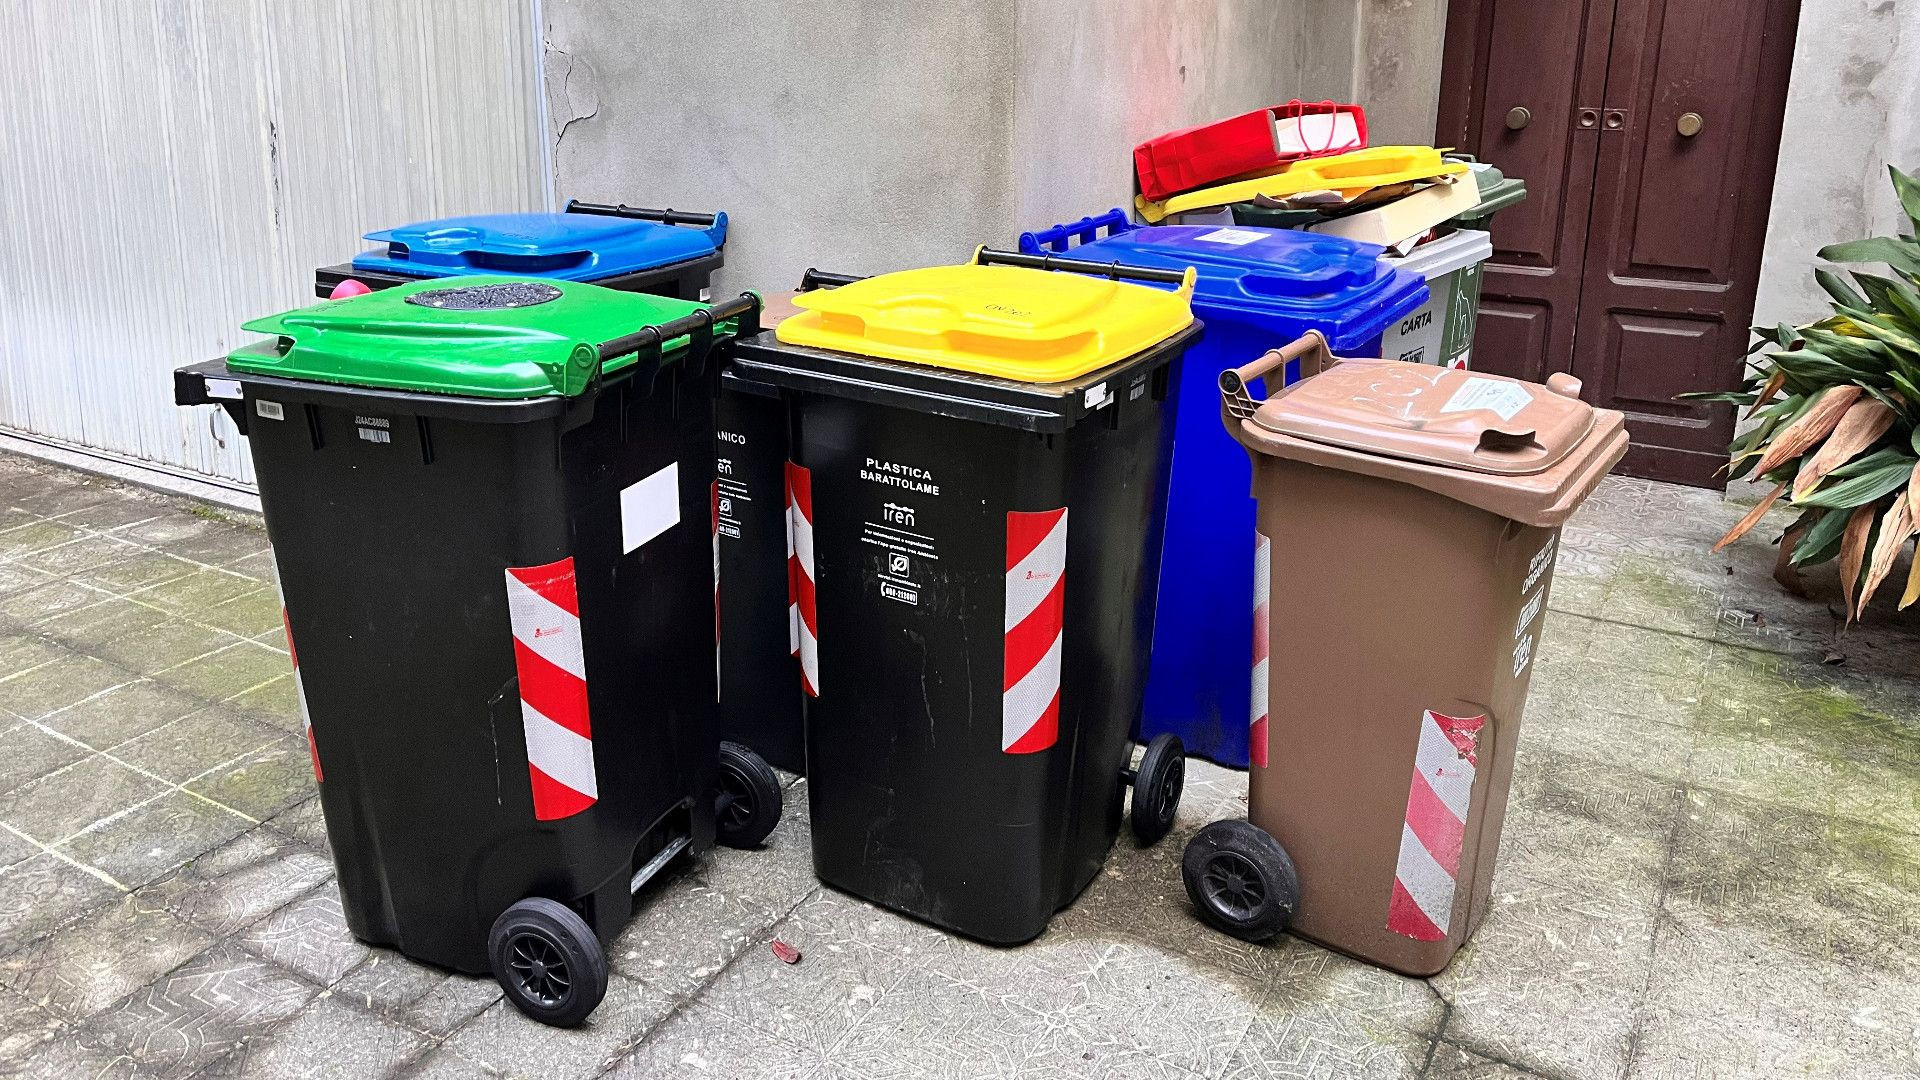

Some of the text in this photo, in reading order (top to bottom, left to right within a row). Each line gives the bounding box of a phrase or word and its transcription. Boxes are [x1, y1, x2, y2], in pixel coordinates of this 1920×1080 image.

[1400, 310, 1432, 337] CARTA
[866, 457, 932, 481] PLASTICA
[860, 469, 940, 496] BARATTOLAME
[883, 503, 915, 527] iren
